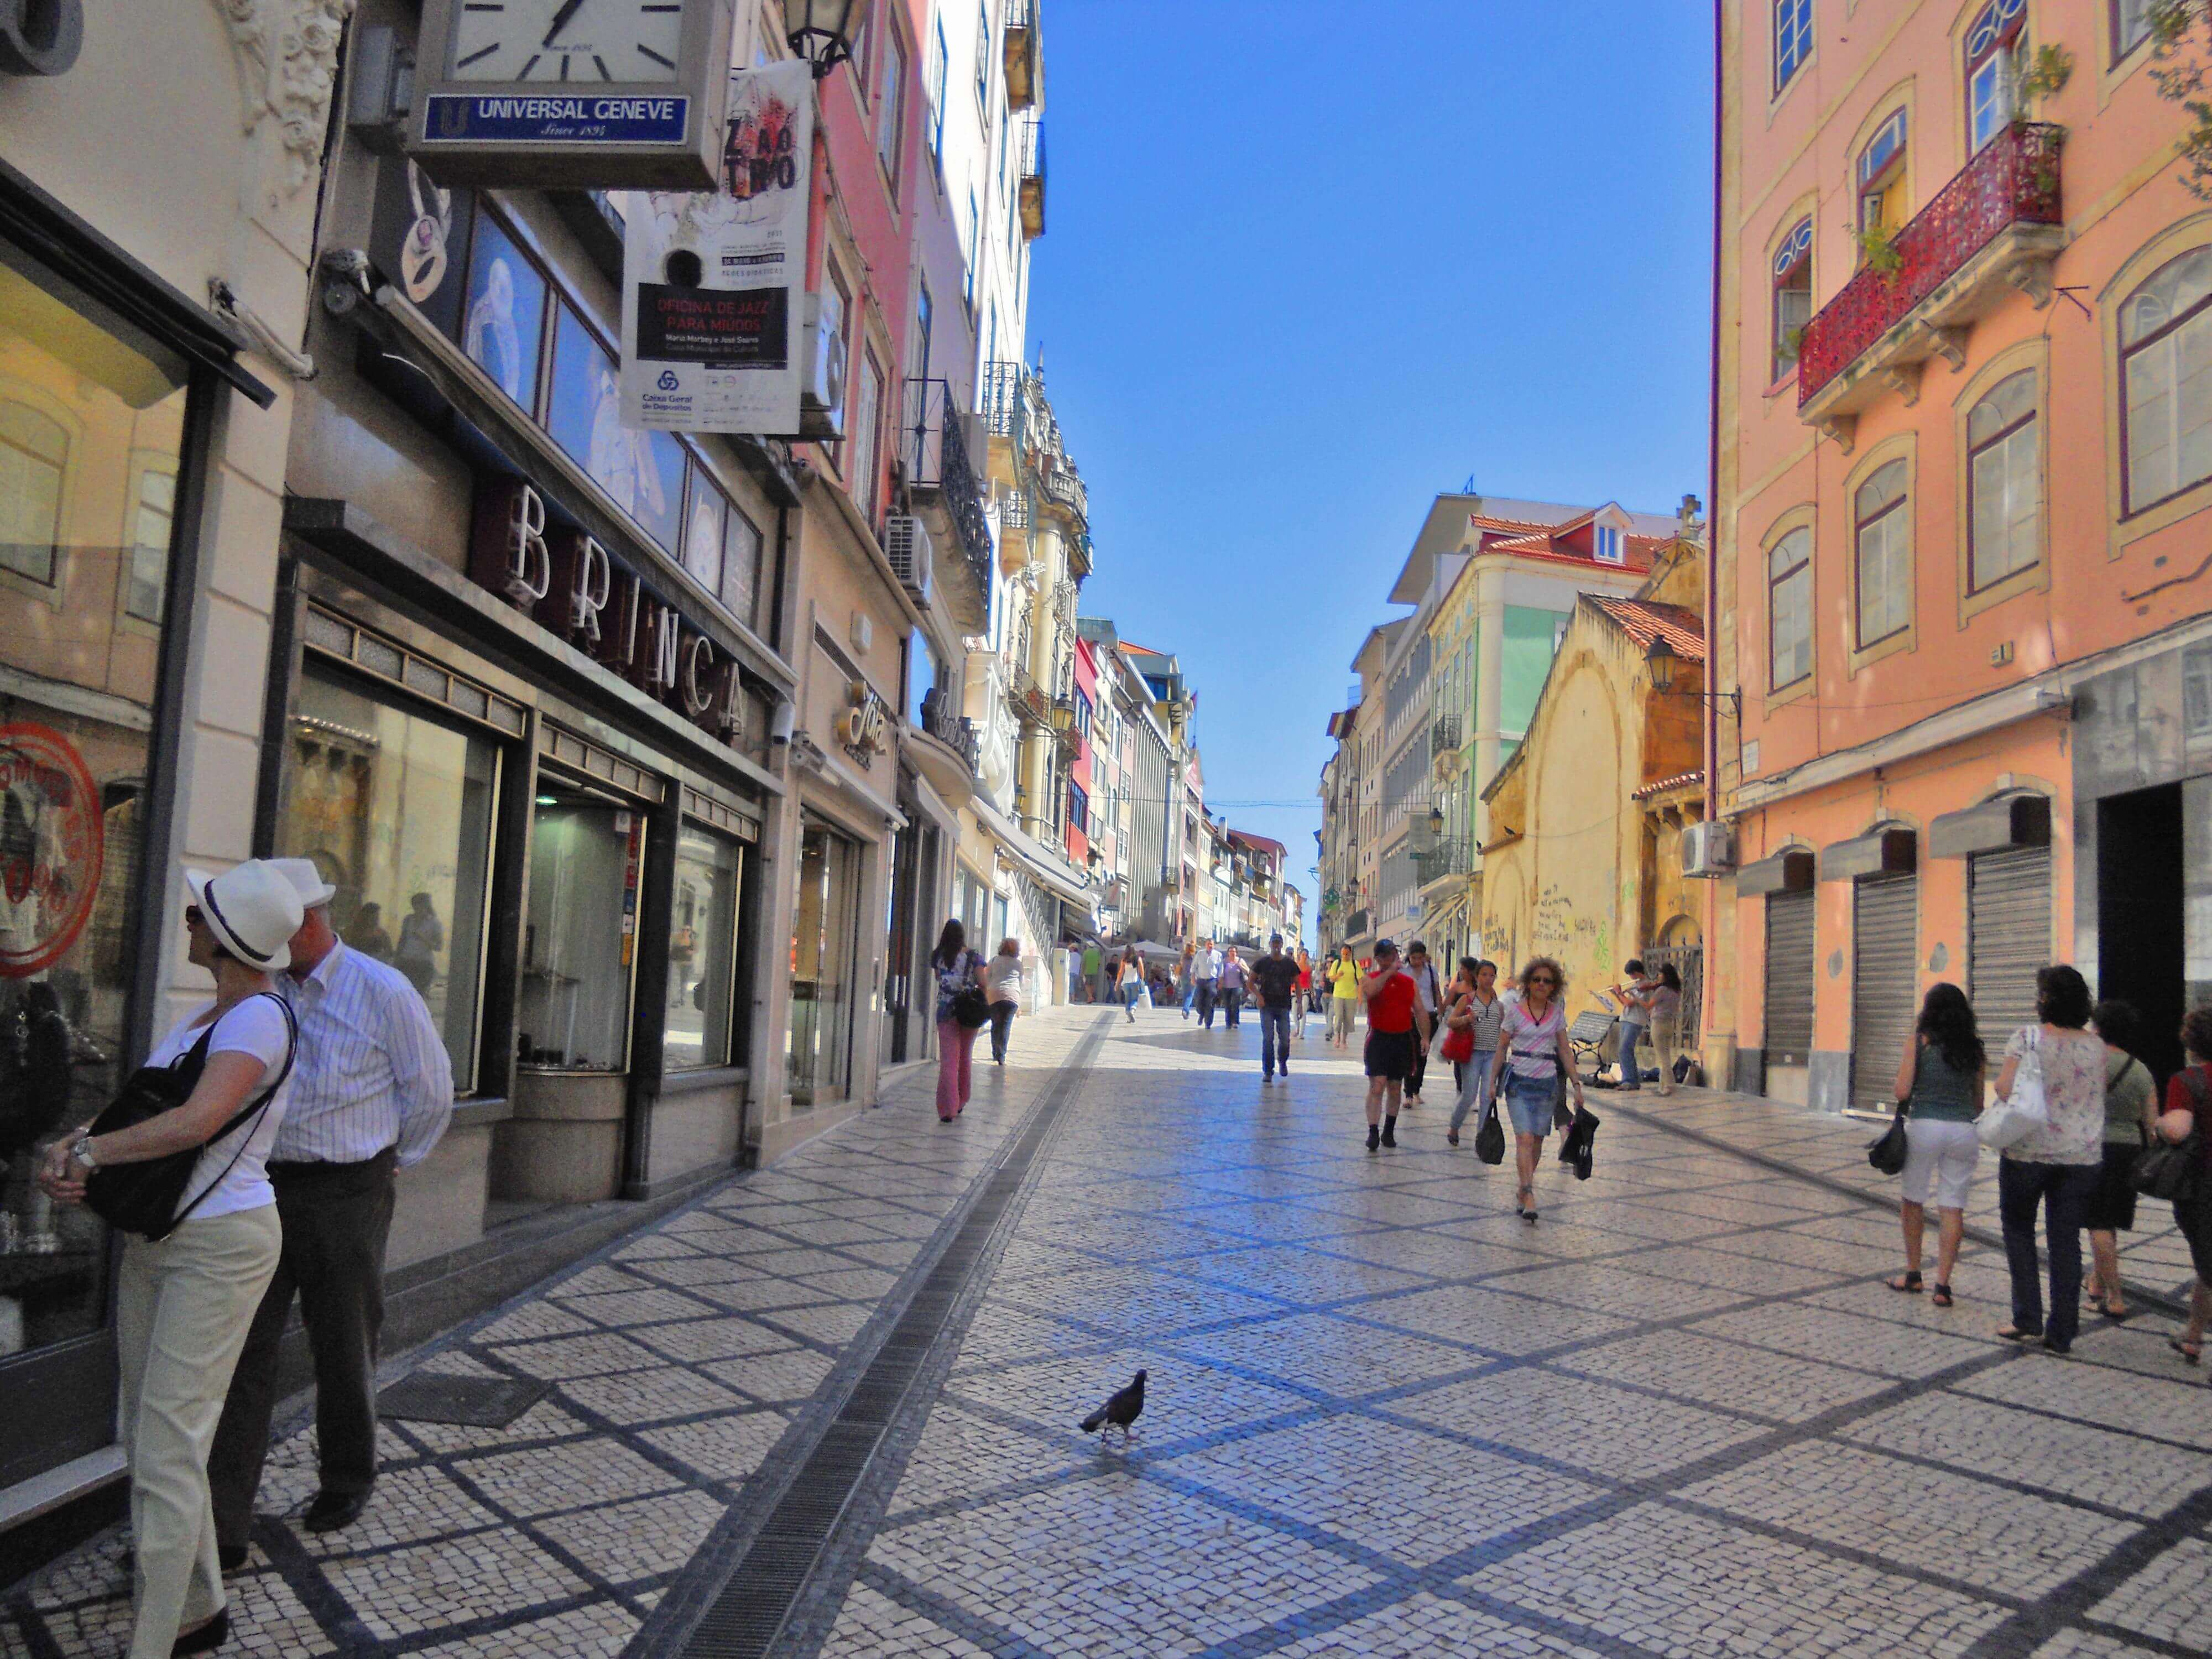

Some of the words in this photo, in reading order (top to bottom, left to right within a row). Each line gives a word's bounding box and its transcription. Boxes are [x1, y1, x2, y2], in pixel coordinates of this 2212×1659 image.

[478, 100, 588, 119] UNIVERSAL
[594, 101, 674, 120] GENEVE
[540, 123, 575, 136] Since
[580, 124, 607, 137] 1894
[657, 298, 712, 314] OFICINA
[717, 301, 734, 315] DE
[738, 300, 770, 315] JAZZ
[667, 316, 706, 331] PARA
[642, 394, 667, 403] Caixa
[669, 395, 692, 404] Geral
[509, 483, 745, 737] BRINCA
